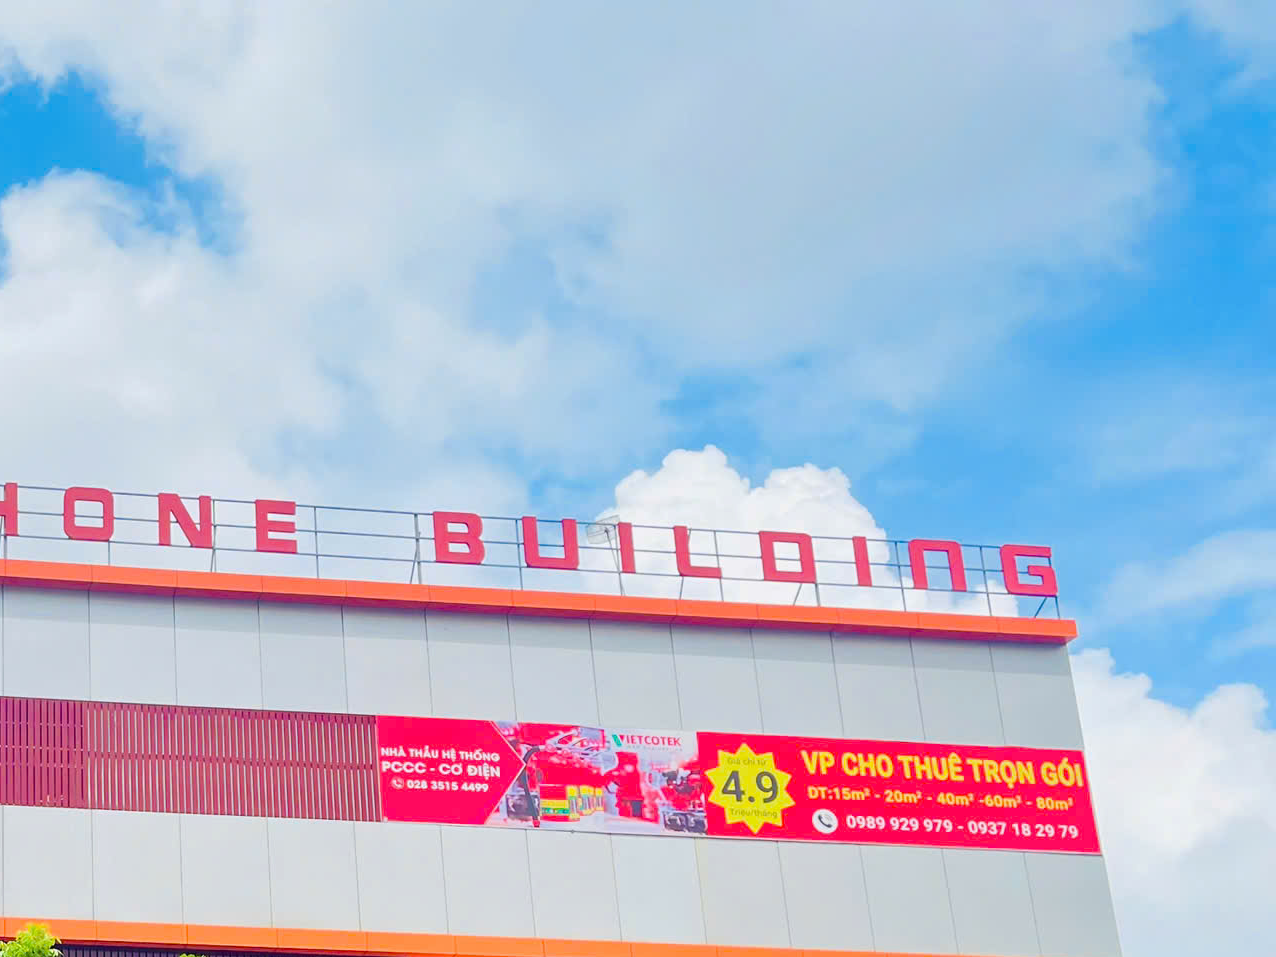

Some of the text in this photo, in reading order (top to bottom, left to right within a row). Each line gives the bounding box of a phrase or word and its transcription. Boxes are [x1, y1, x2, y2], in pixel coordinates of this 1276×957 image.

[433, 511, 1058, 596] BUILDING
[381, 745, 406, 757] NHÀ
[441, 748, 456, 762] HỆ
[459, 748, 500, 762] THỐNG
[382, 761, 426, 773] PCCC
[438, 762, 463, 775] CƠ
[467, 763, 500, 780] ĐIỆN
[801, 750, 1084, 789] VP CHO THUÊ TRỌN GÓI
[407, 780, 488, 792] 028 3515 4499
[722, 770, 778, 803] 4.9
[846, 815, 885, 829] 0989
[890, 817, 919, 831] 929
[924, 819, 953, 832] 979
[967, 820, 1006, 835] 0937
[1012, 823, 1031, 836] 18
[1035, 824, 1055, 837] 29
[1058, 825, 1079, 838] 79
